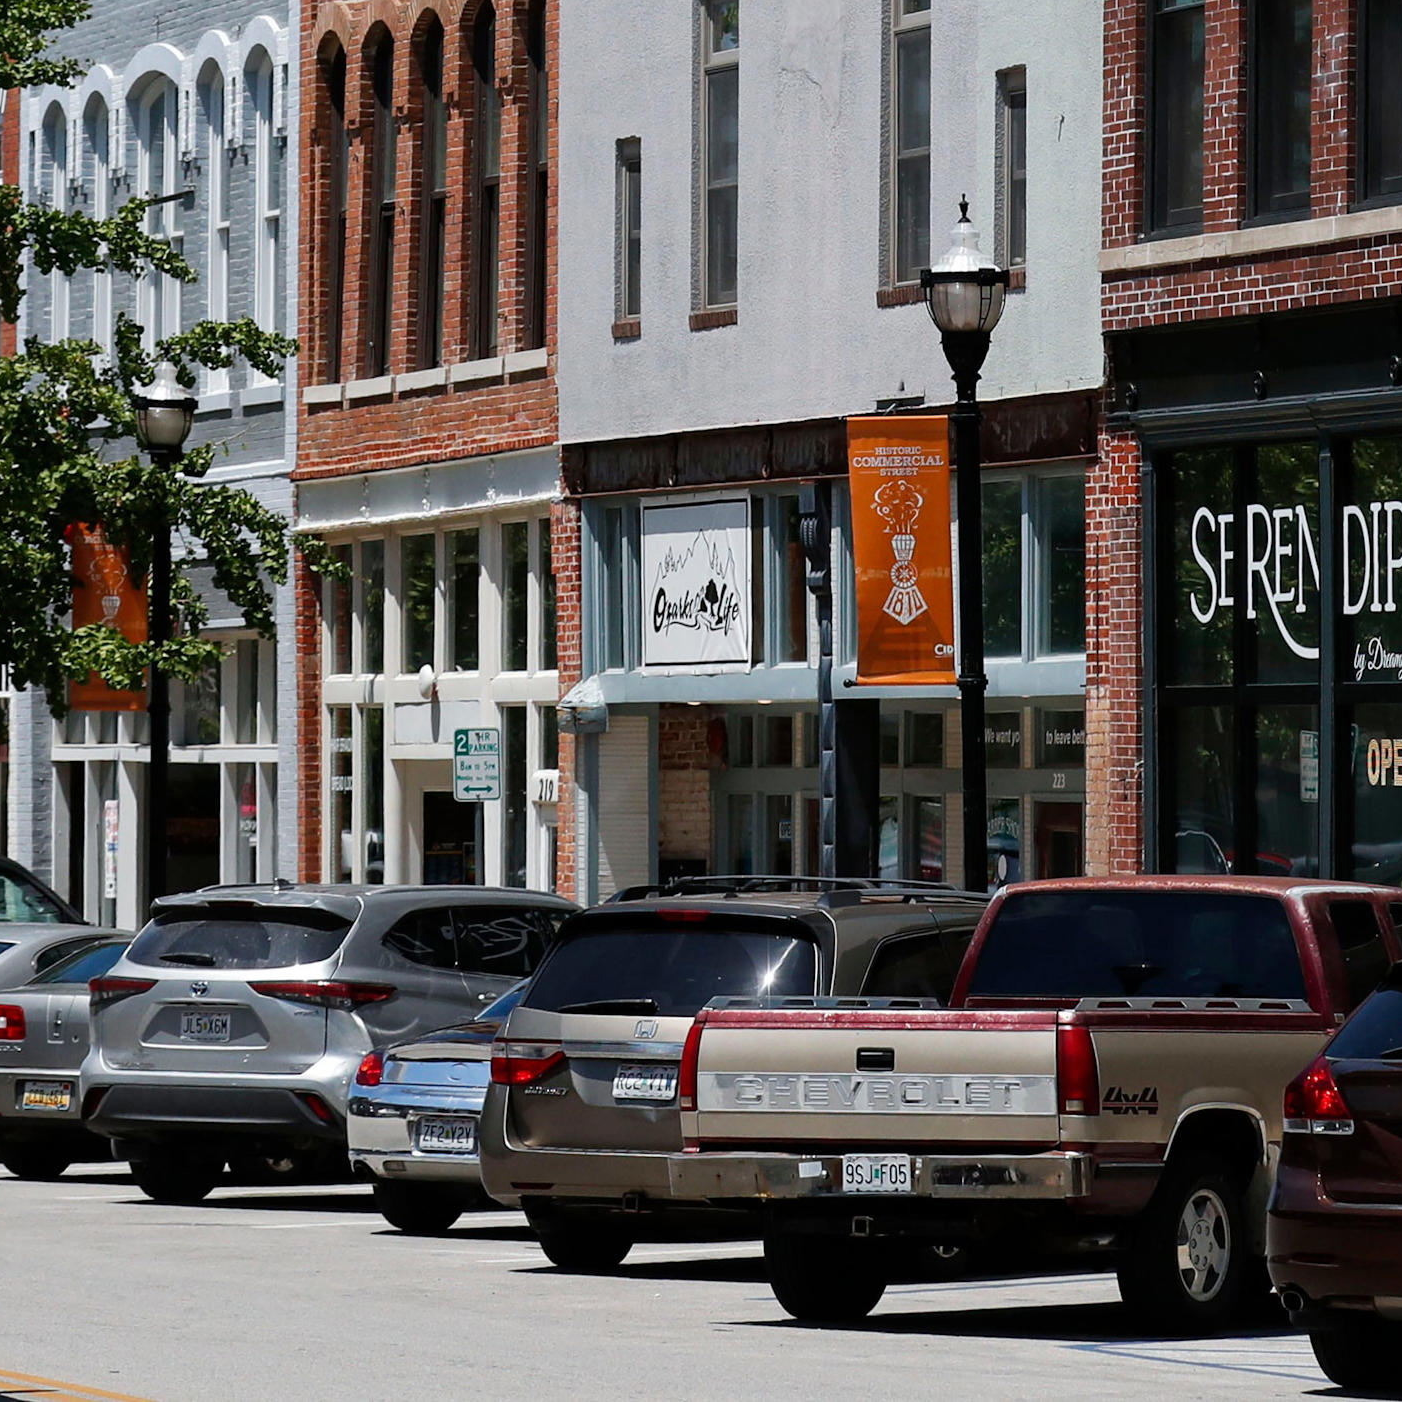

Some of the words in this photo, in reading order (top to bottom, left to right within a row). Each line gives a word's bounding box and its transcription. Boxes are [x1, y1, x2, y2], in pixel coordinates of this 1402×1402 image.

[875, 446, 922, 455] HISTORIC
[853, 455, 944, 468] COMMERCIAL
[880, 468, 918, 476] STREET
[653, 586, 694, 636] Ozarks
[715, 583, 739, 637] Life
[886, 588, 924, 618] 1870
[934, 643, 954, 656] CID
[1354, 643, 1366, 681] by
[456, 734, 467, 753] 2
[1054, 728, 1071, 744] leave
[468, 743, 498, 753] PARKING
[1052, 773, 1066, 788] 223
[539, 778, 554, 801] 219
[734, 1077, 1021, 1108] CHEVROLET
